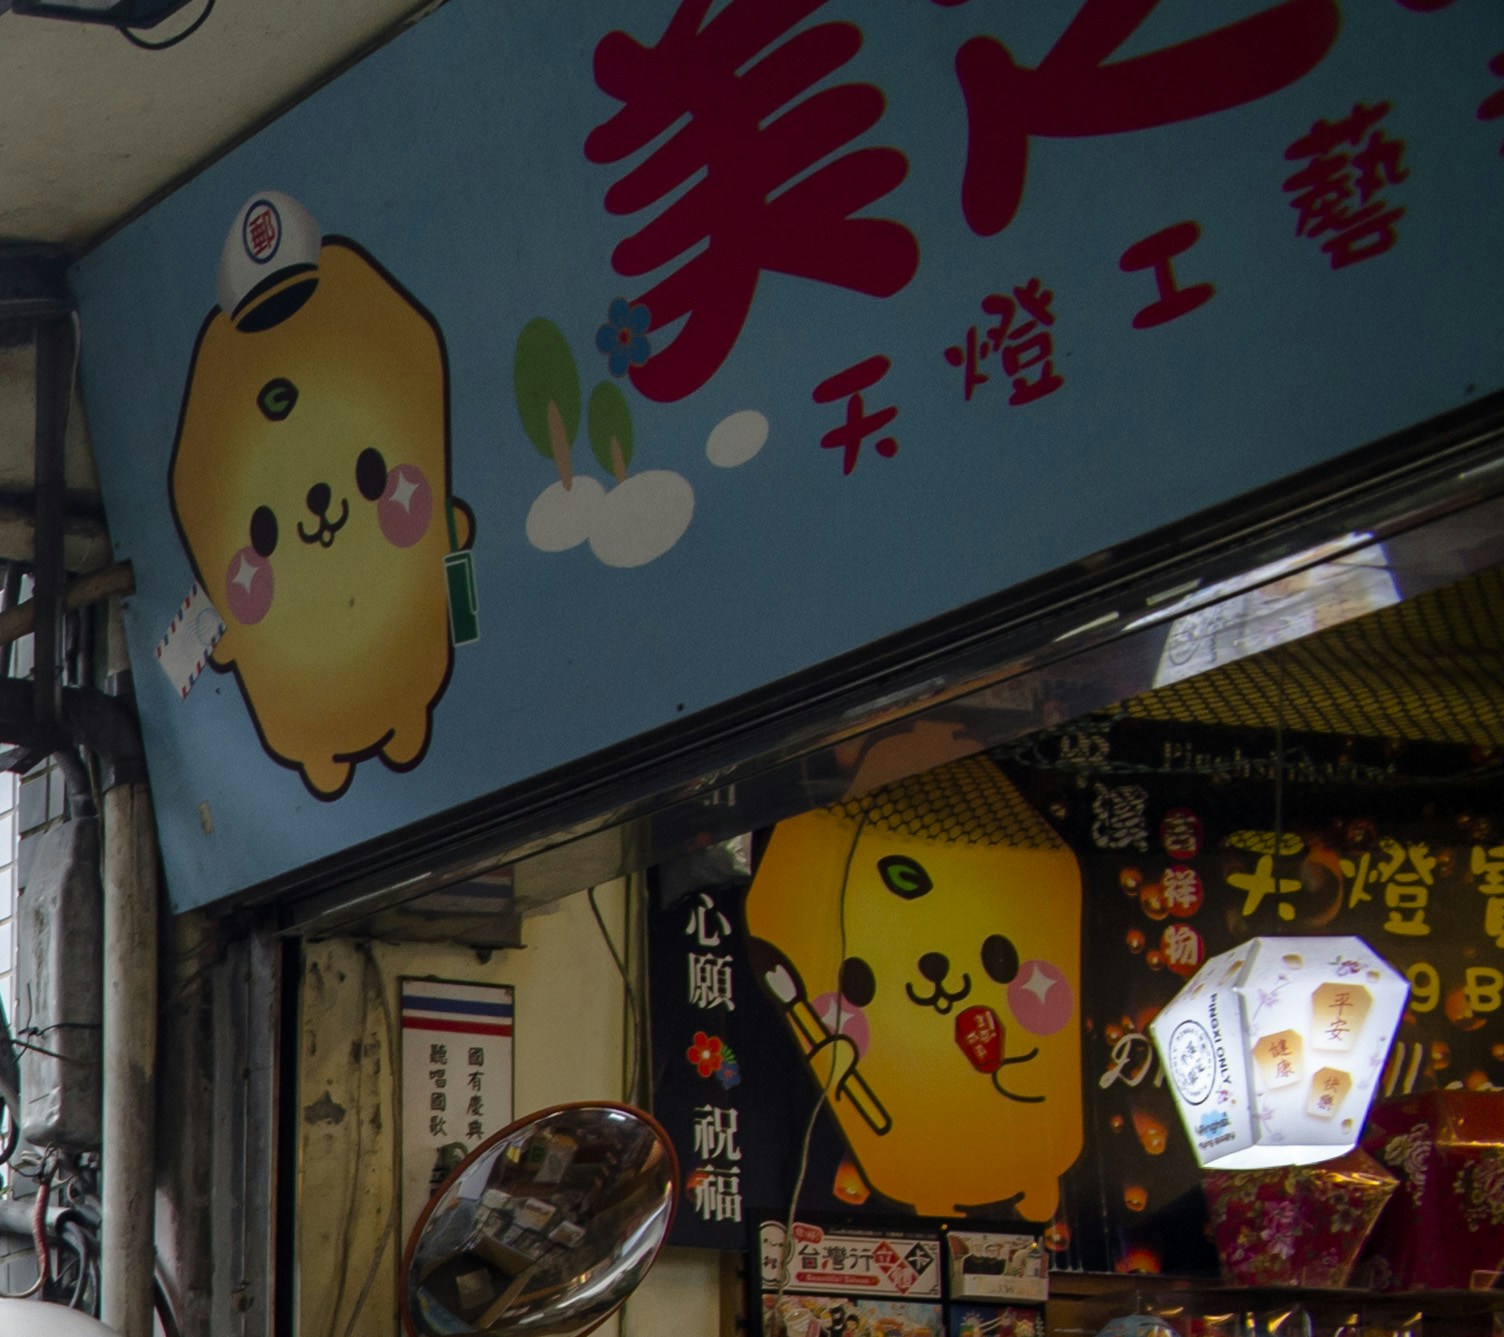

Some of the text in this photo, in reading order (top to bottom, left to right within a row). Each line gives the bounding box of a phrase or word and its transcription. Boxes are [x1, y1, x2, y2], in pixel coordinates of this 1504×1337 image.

[1327, 992, 1354, 1041] 平安
[685, 892, 745, 1225] 心願 祝福
[1267, 1038, 1295, 1078] 健康
